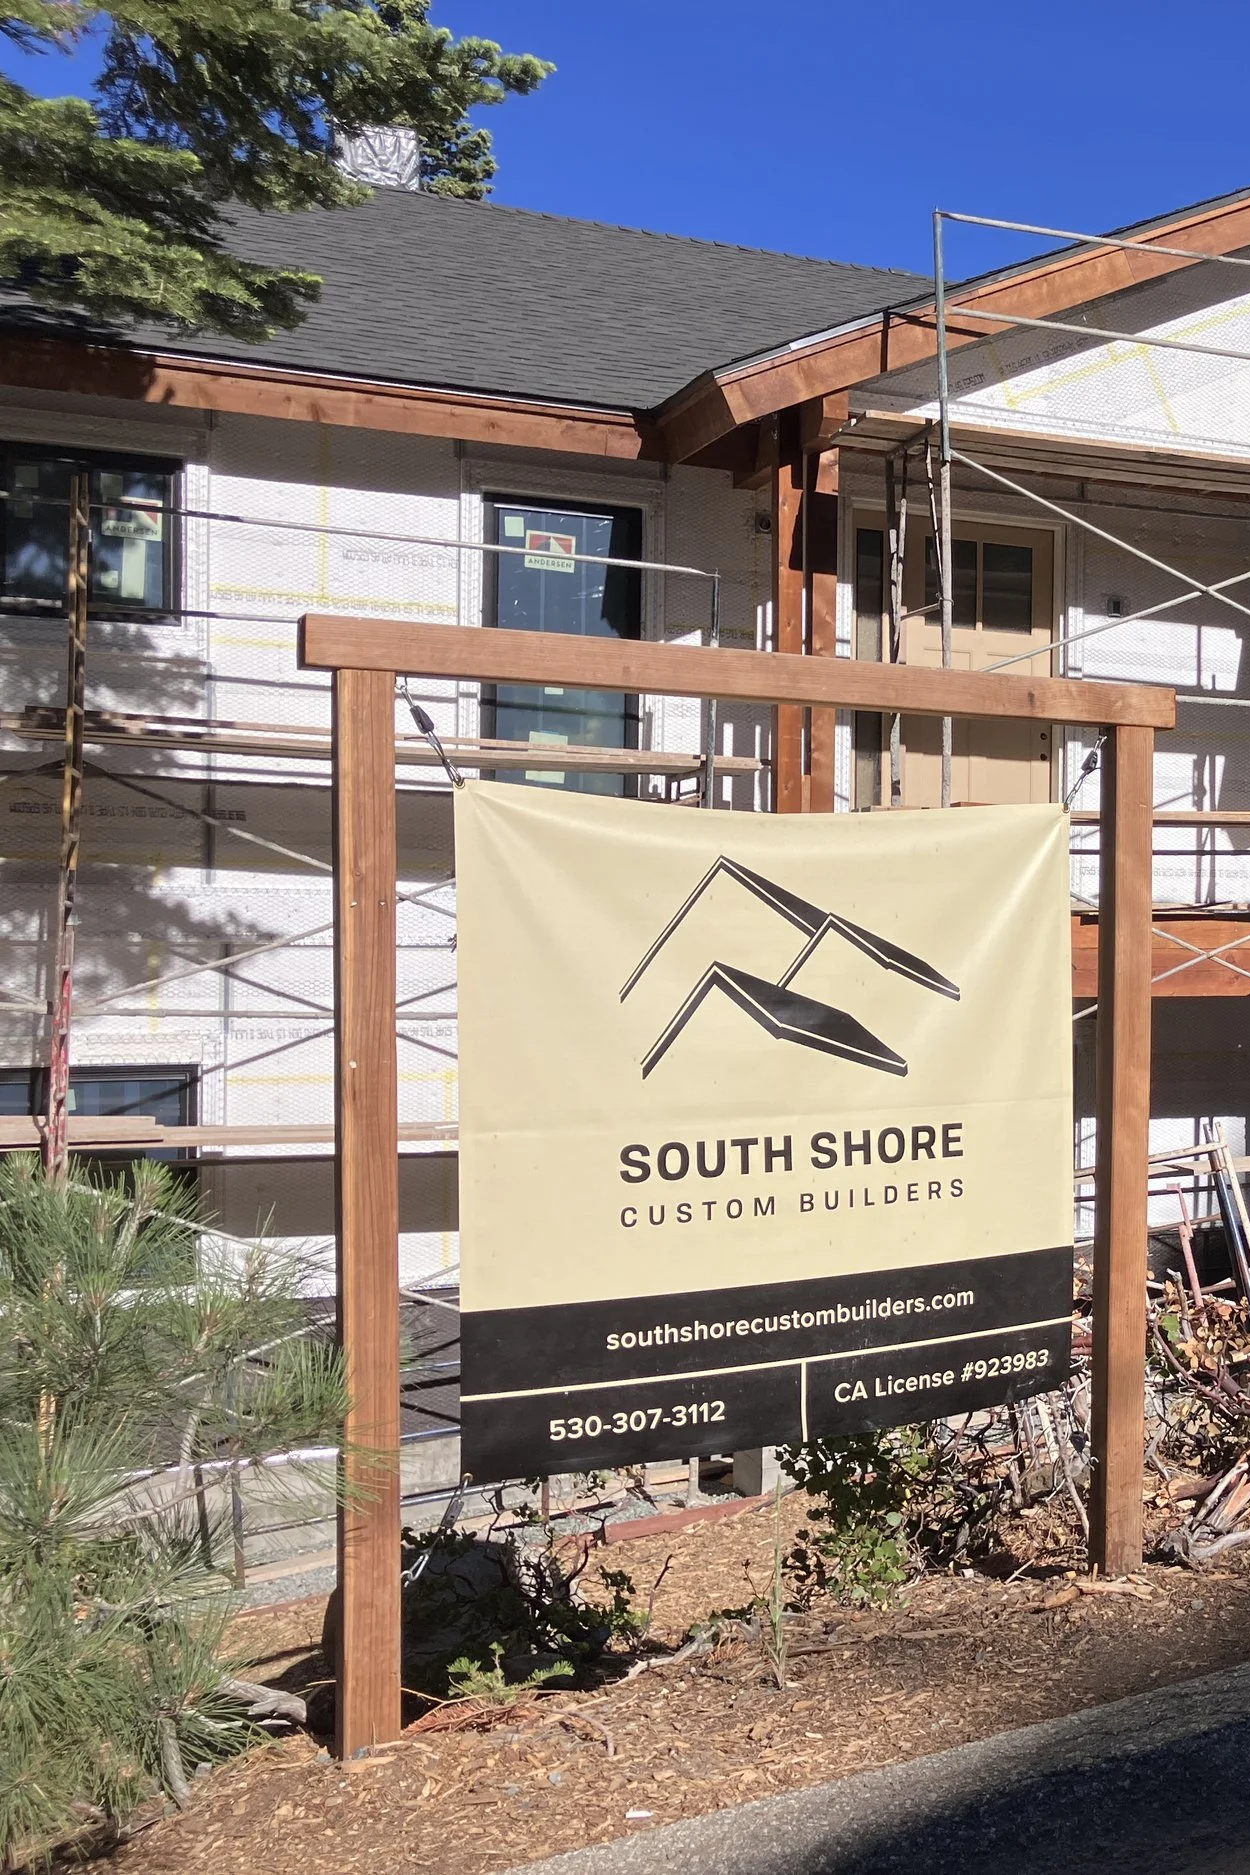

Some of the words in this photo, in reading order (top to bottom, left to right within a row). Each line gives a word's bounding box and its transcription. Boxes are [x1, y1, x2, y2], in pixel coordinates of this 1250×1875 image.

[104, 525, 158, 536] ANDERSEN
[528, 558, 572, 569] ANDERSEN
[619, 1135, 793, 1184] SOUTH
[810, 1122, 964, 1170] SHORE
[620, 1196, 776, 1228] CUSTOM
[800, 1178, 964, 1213] BUILDERS
[606, 1289, 975, 1351] southshorecustombuilders.com
[834, 1380, 869, 1404] CA
[875, 1369, 955, 1398] License
[961, 1348, 1050, 1384] #923983
[549, 1400, 726, 1441] 530-307-3112
